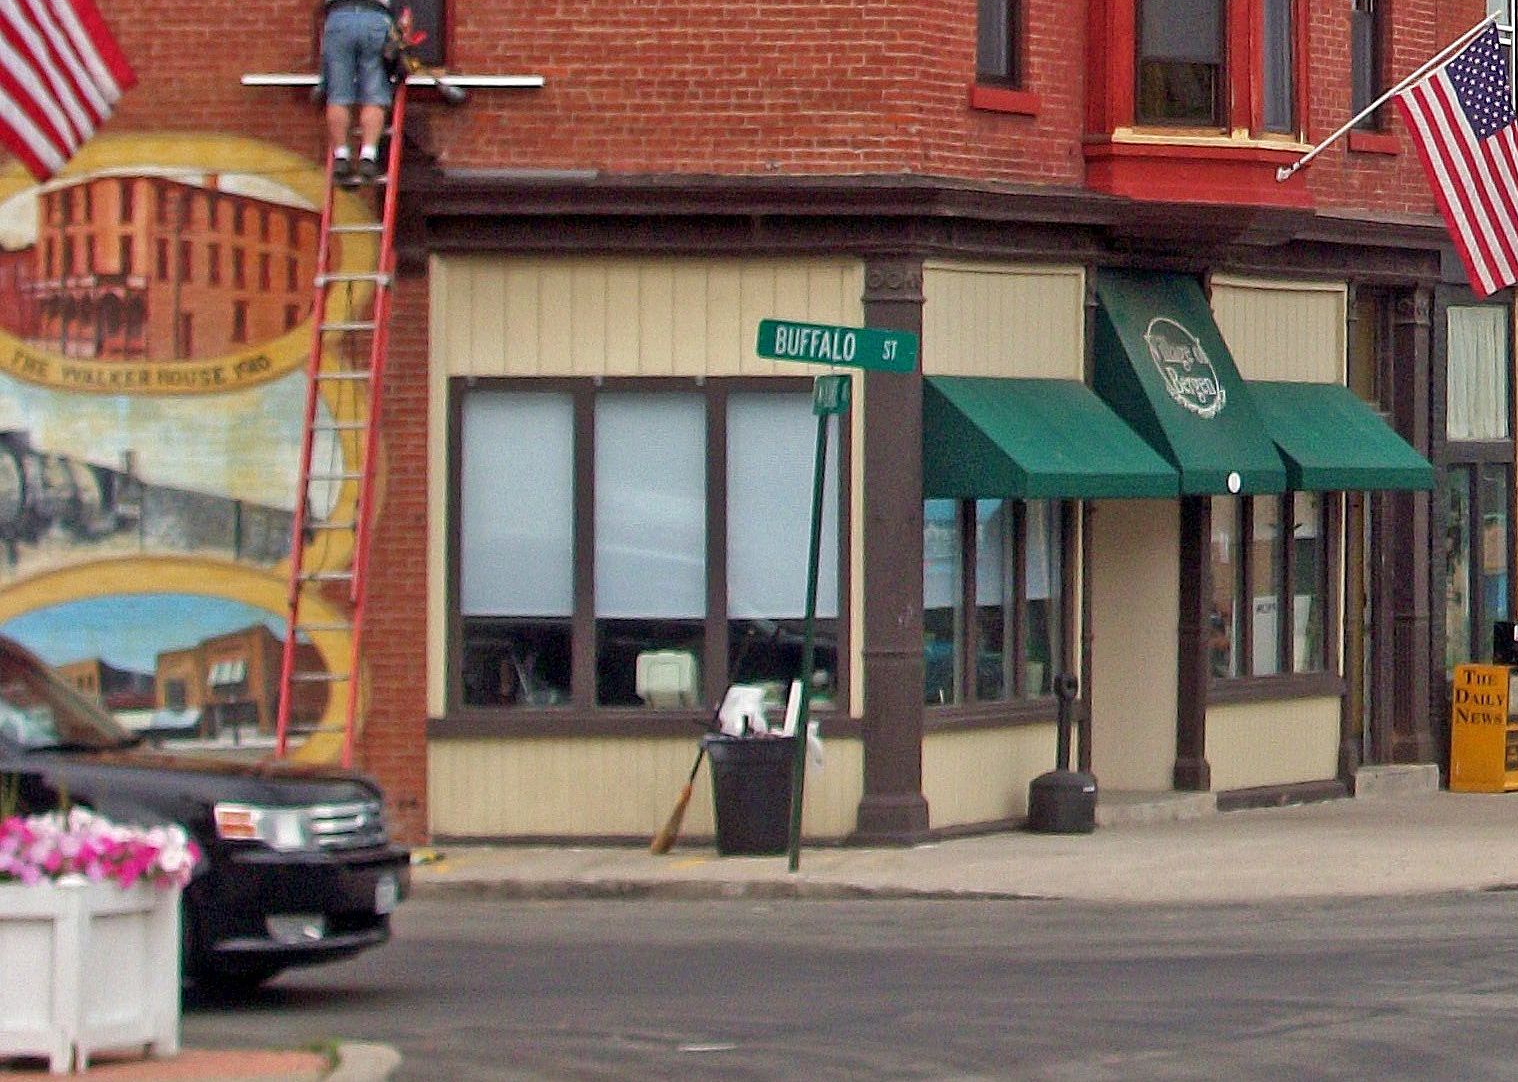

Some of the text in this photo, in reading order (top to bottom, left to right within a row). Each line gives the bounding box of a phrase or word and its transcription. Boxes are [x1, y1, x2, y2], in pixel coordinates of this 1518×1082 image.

[775, 325, 898, 362] BUFFALO ST
[1463, 669, 1497, 685] THE
[1456, 688, 1505, 706] DAILY
[1456, 707, 1503, 725] NEWS
